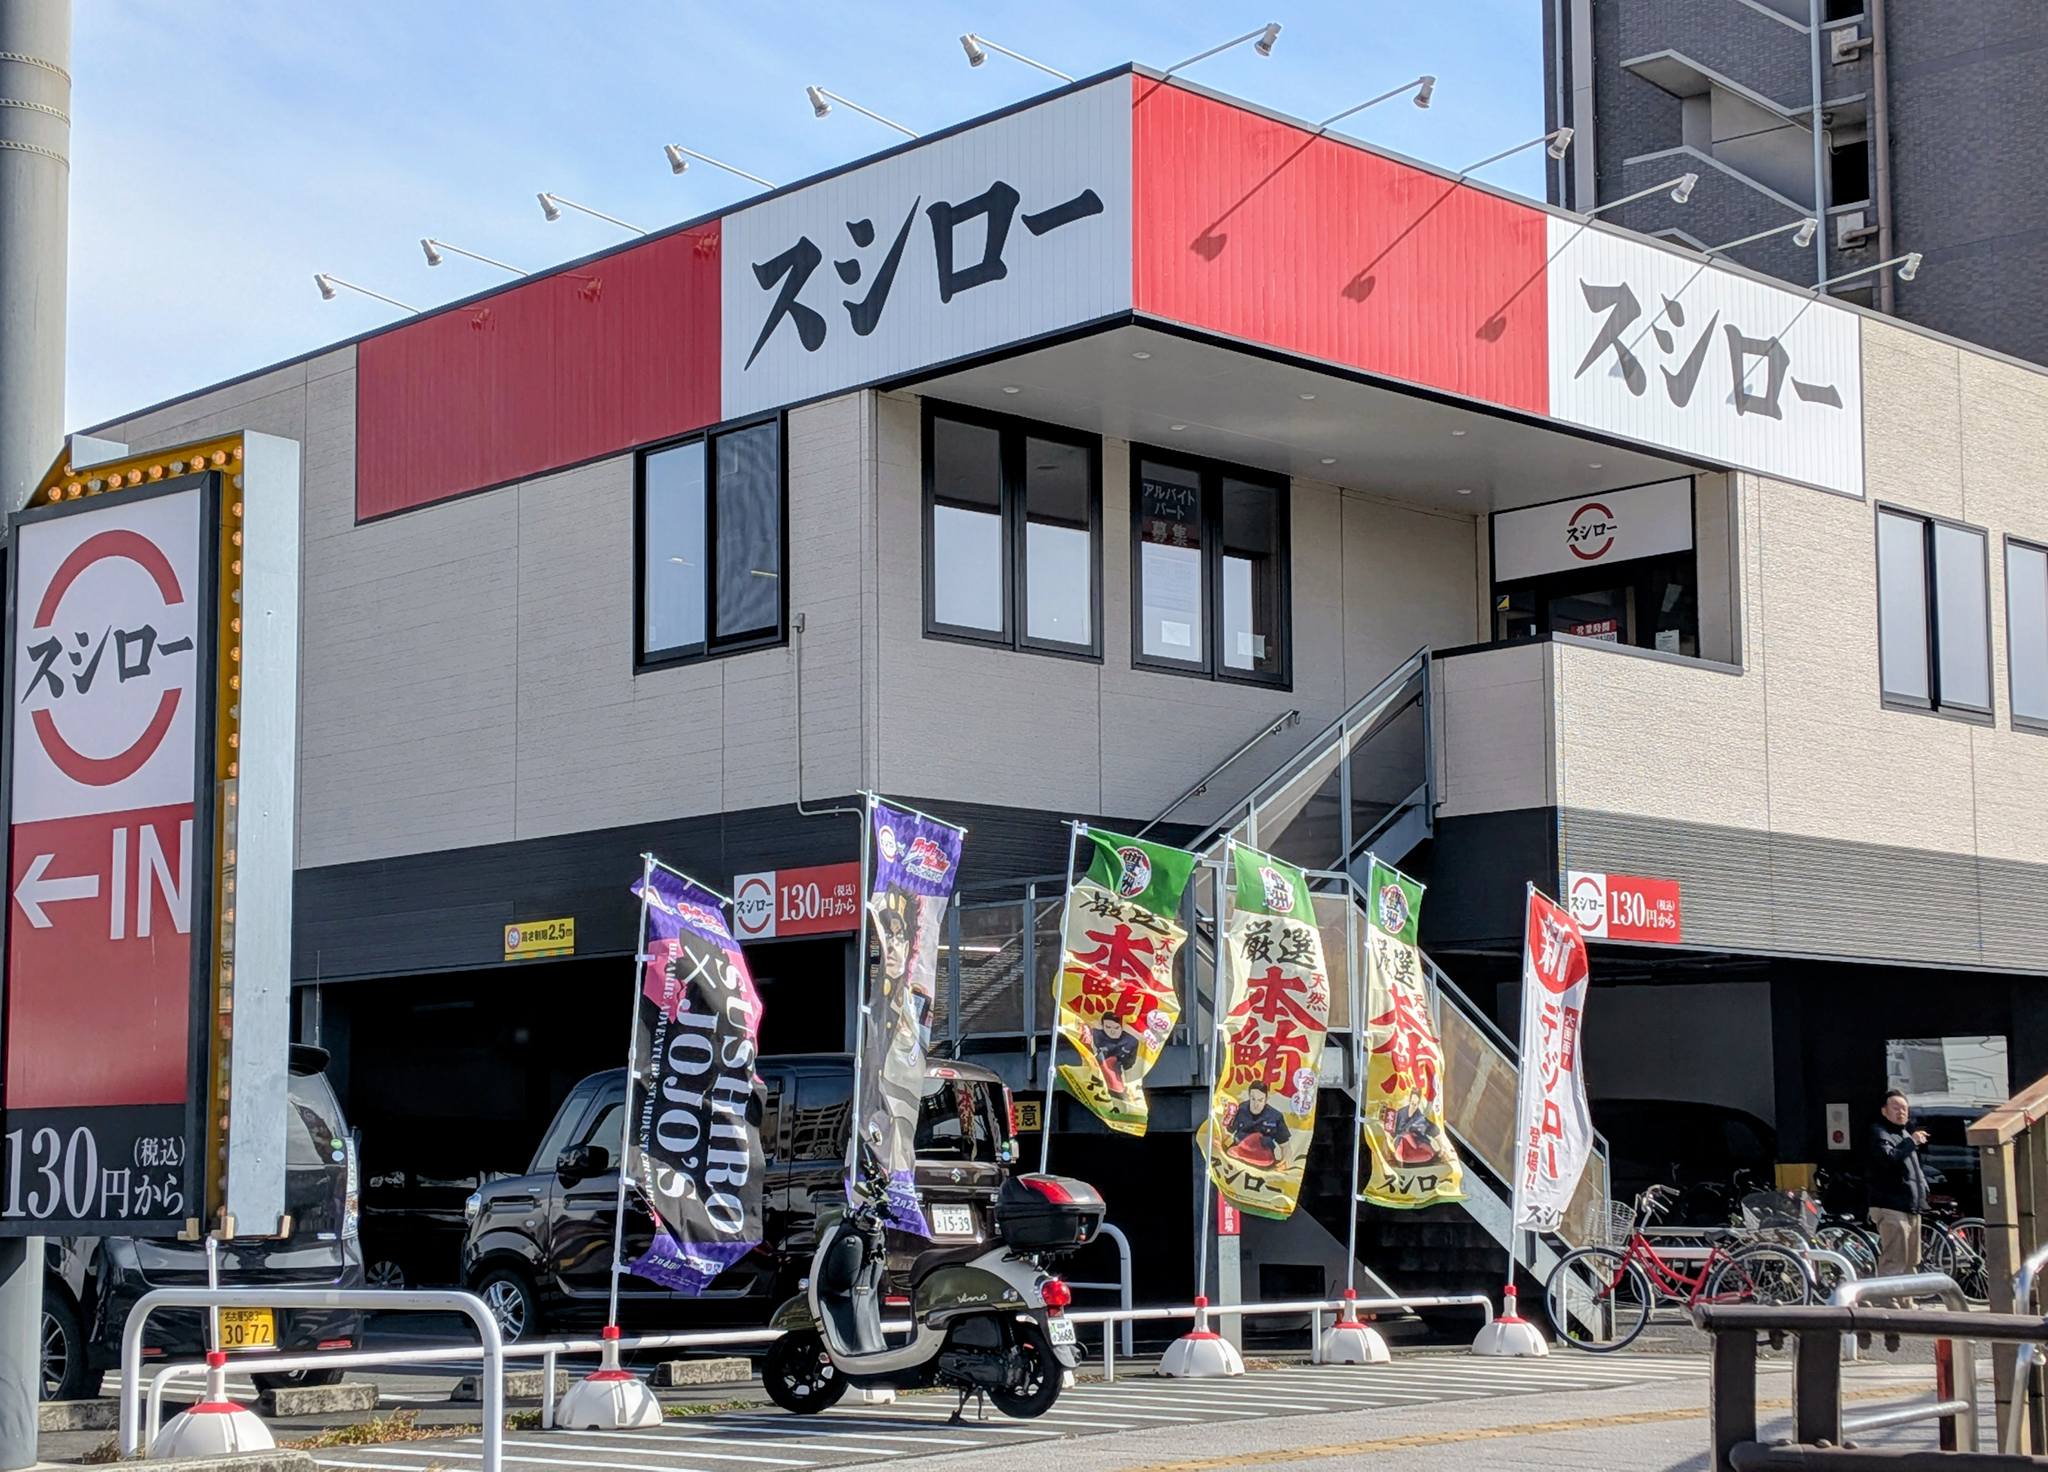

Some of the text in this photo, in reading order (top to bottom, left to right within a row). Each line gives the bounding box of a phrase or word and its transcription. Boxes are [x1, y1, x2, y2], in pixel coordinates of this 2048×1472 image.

[744, 180, 1105, 372] スシロー
[1574, 276, 1844, 421] スシロー
[1143, 483, 1195, 506] アルバイト
[1154, 502, 1185, 520] パート
[1566, 523, 1618, 543] スシロー
[20, 623, 194, 704] スシロー
[110, 819, 194, 940] IN
[780, 882, 856, 922] 130円から
[1571, 897, 1604, 911] スシロー
[736, 899, 774, 915] スシロー
[1610, 890, 1676, 929] 130円から
[1240, 920, 1317, 970] 厳選
[1539, 913, 1576, 983] 新
[1307, 974, 1328, 1012] 天然
[1224, 965, 1328, 1098] 本鮪
[656, 998, 720, 1201] JOJO'S
[704, 957, 756, 1234] SUSHIRO
[1539, 1002, 1563, 1179] デジロー
[639, 1081, 657, 1152] STARDUST
[2, 1126, 185, 1219] 130円から
[134, 1135, 185, 1168] (税込)
[1377, 1174, 1453, 1195] スシロー
[225, 1324, 270, 1344] 30-72
